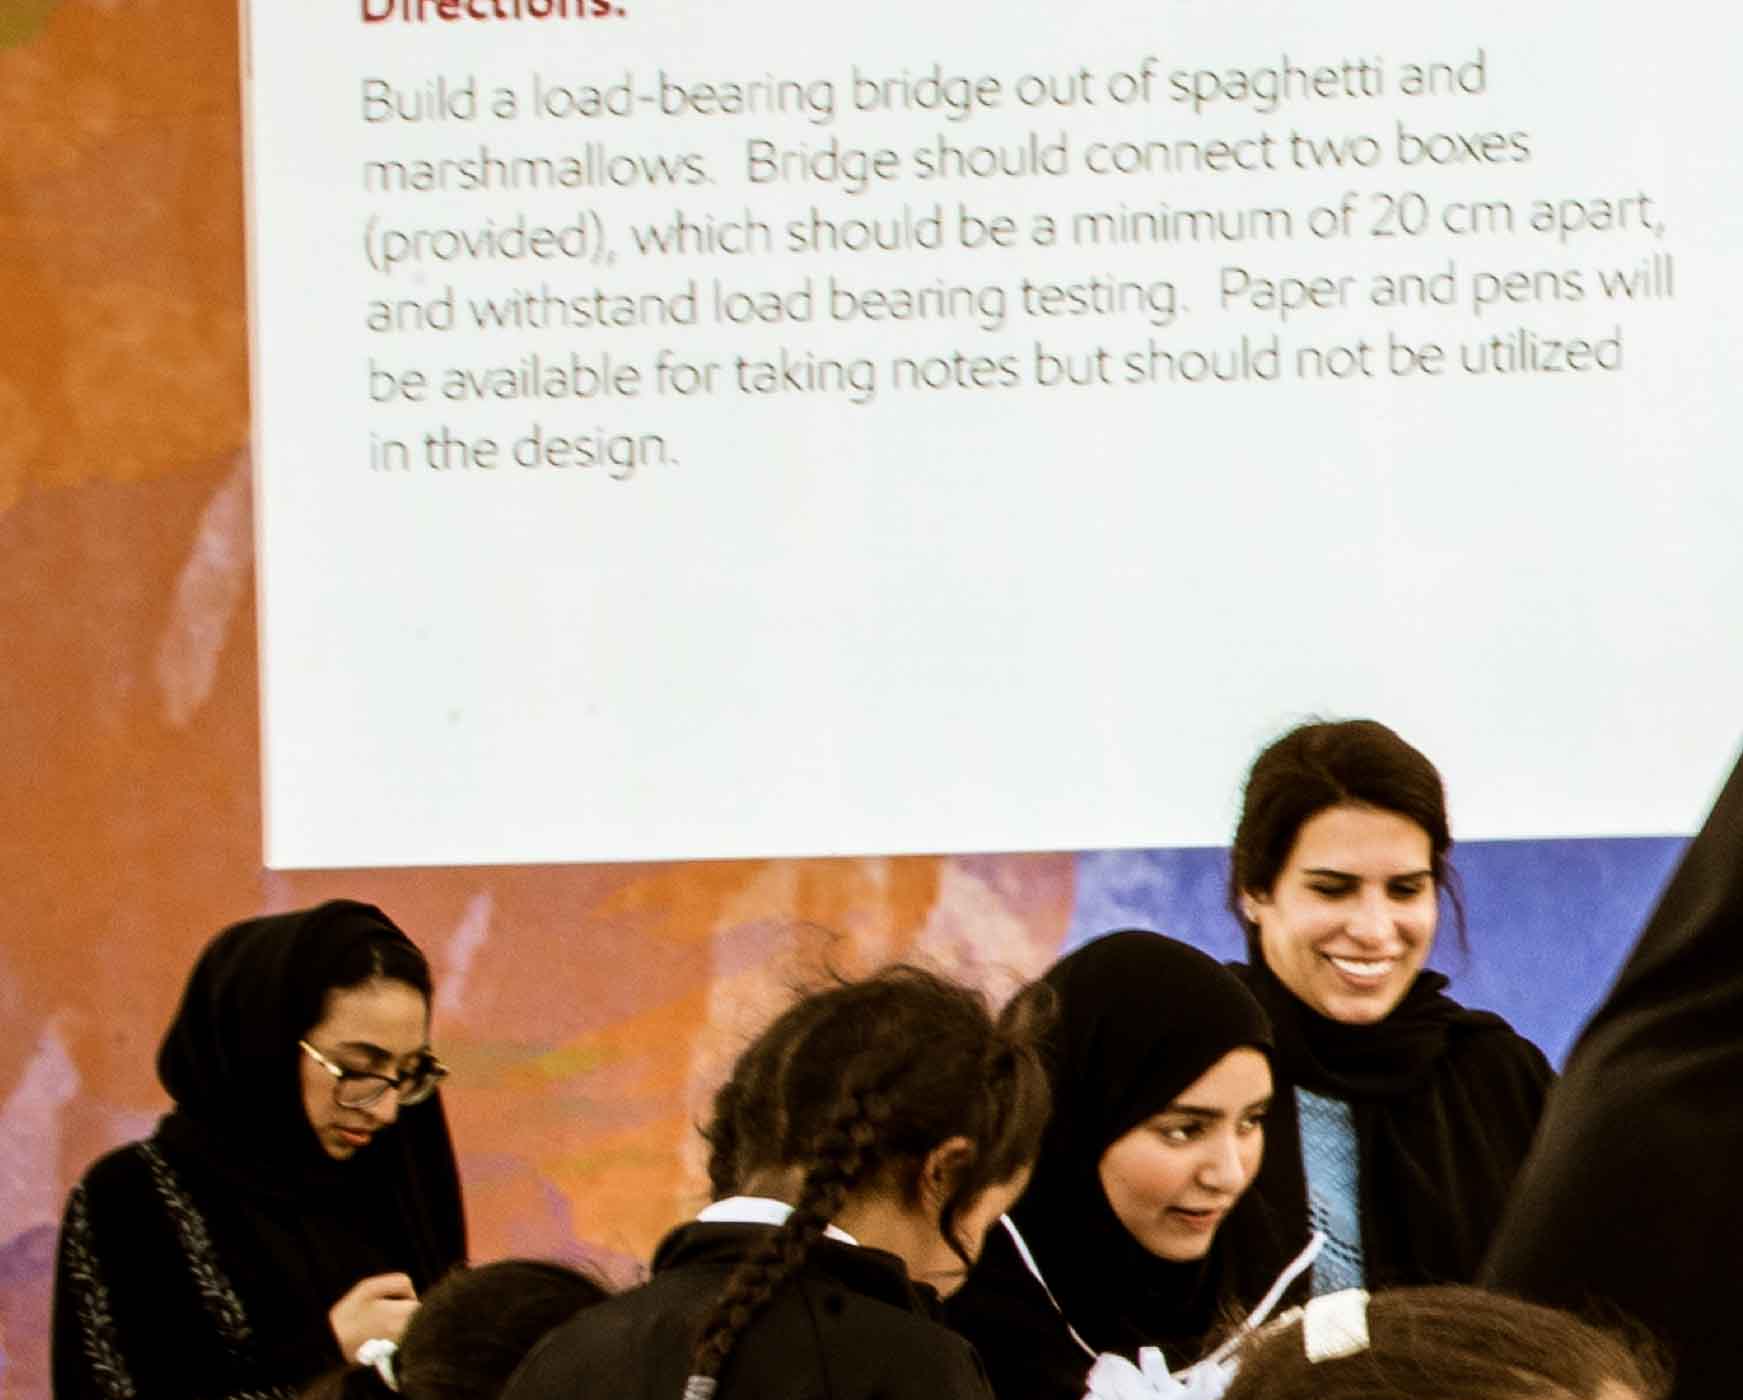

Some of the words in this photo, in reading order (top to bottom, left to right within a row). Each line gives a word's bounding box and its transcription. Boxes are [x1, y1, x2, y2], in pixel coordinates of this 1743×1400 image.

[362, 75, 477, 124] Build
[491, 87, 518, 121] a
[534, 69, 836, 127] load-bearing
[852, 63, 1003, 123] bridge
[1015, 67, 1095, 108] out
[1106, 57, 1159, 105] of
[1167, 53, 1384, 116] spaghetti
[1399, 47, 1487, 97] and
[364, 141, 715, 193] marshmallows.
[746, 136, 901, 195] Bridge
[913, 131, 1068, 180] should
[1084, 131, 1277, 175] connect
[1288, 130, 1381, 169] two
[1396, 119, 1531, 166] boxes
[363, 209, 615, 271] (provided),
[630, 209, 771, 256] which
[786, 203, 944, 253] should
[958, 202, 1018, 249] be
[1031, 215, 1057, 247] a
[1073, 202, 1293, 244] minimum
[1307, 191, 1359, 240] of
[1370, 191, 1430, 237] 20
[1441, 201, 1514, 235] cm
[1529, 192, 1665, 244] apart,
[365, 285, 455, 333] and
[468, 279, 697, 329] withstand
[713, 277, 813, 325] load
[828, 276, 1007, 333] bearing
[1020, 277, 1188, 328] testing.
[1220, 266, 1356, 322] Paper
[1369, 260, 1457, 307] and
[1473, 269, 1585, 316] pens
[1597, 253, 1673, 300] will
[369, 358, 428, 403] be
[441, 351, 642, 401] available
[654, 348, 721, 396] for
[732, 347, 876, 406] taking
[892, 349, 1021, 391] notes
[1034, 340, 1113, 387] but
[1123, 334, 1281, 385] should
[1295, 340, 1374, 380] not
[1388, 331, 1445, 377] be
[1460, 325, 1622, 375] utilized
[370, 431, 409, 471] in
[423, 425, 500, 471] the
[511, 423, 679, 482] design.
